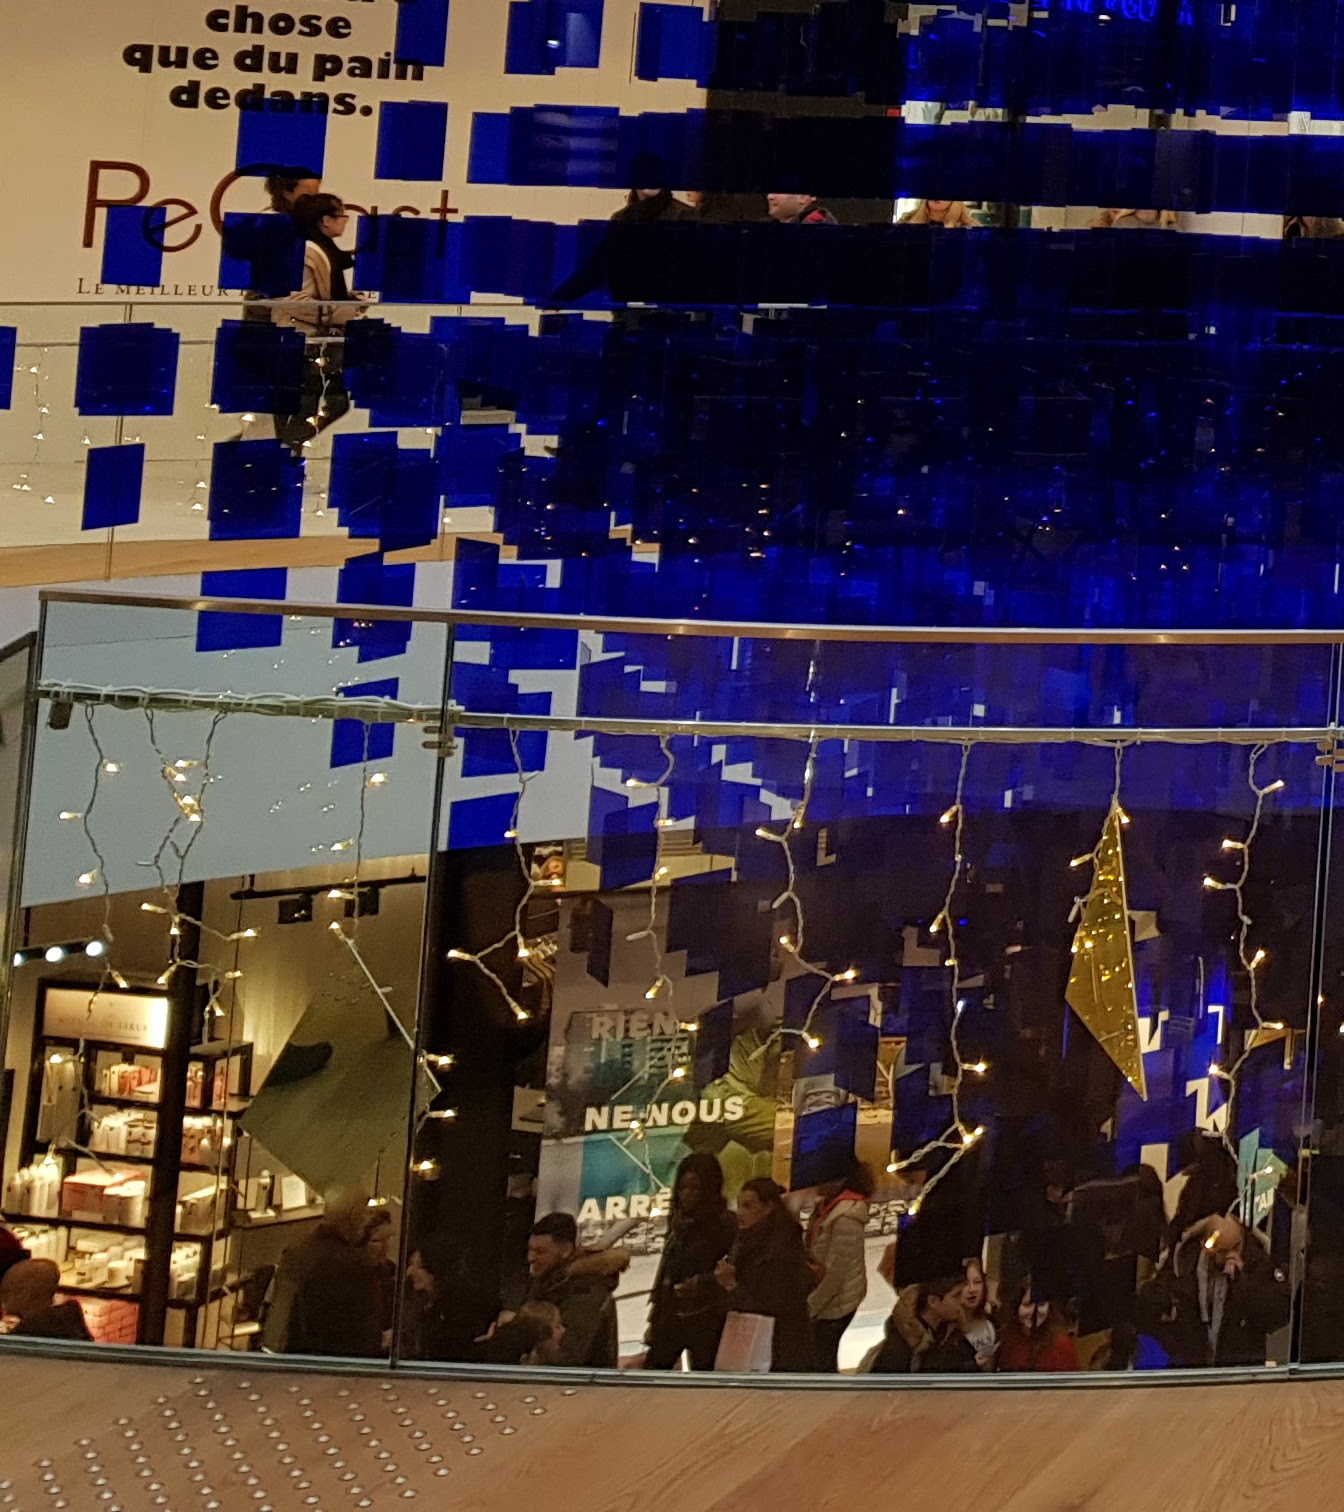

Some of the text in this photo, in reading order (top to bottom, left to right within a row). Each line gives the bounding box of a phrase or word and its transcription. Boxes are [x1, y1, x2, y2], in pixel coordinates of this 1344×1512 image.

[205, 4, 352, 39] chose
[122, 42, 424, 82] que du pain
[585, 1095, 745, 1131] NE NOUS
